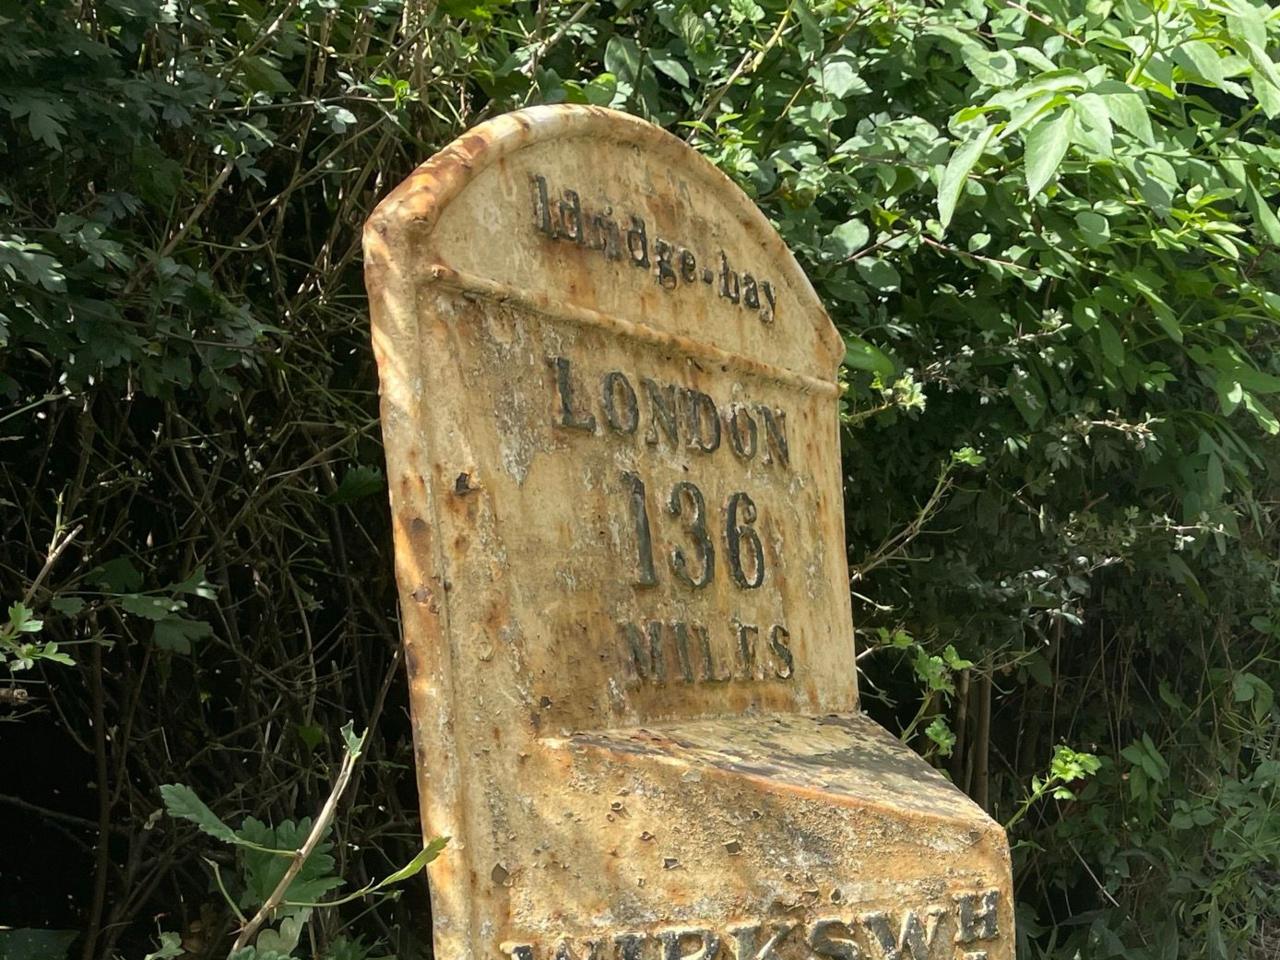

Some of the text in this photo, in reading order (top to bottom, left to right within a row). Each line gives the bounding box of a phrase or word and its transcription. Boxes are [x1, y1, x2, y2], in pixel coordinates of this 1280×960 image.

[547, 356, 791, 468] LONDON
[619, 470, 765, 590] 136
[618, 617, 795, 688] MILES
